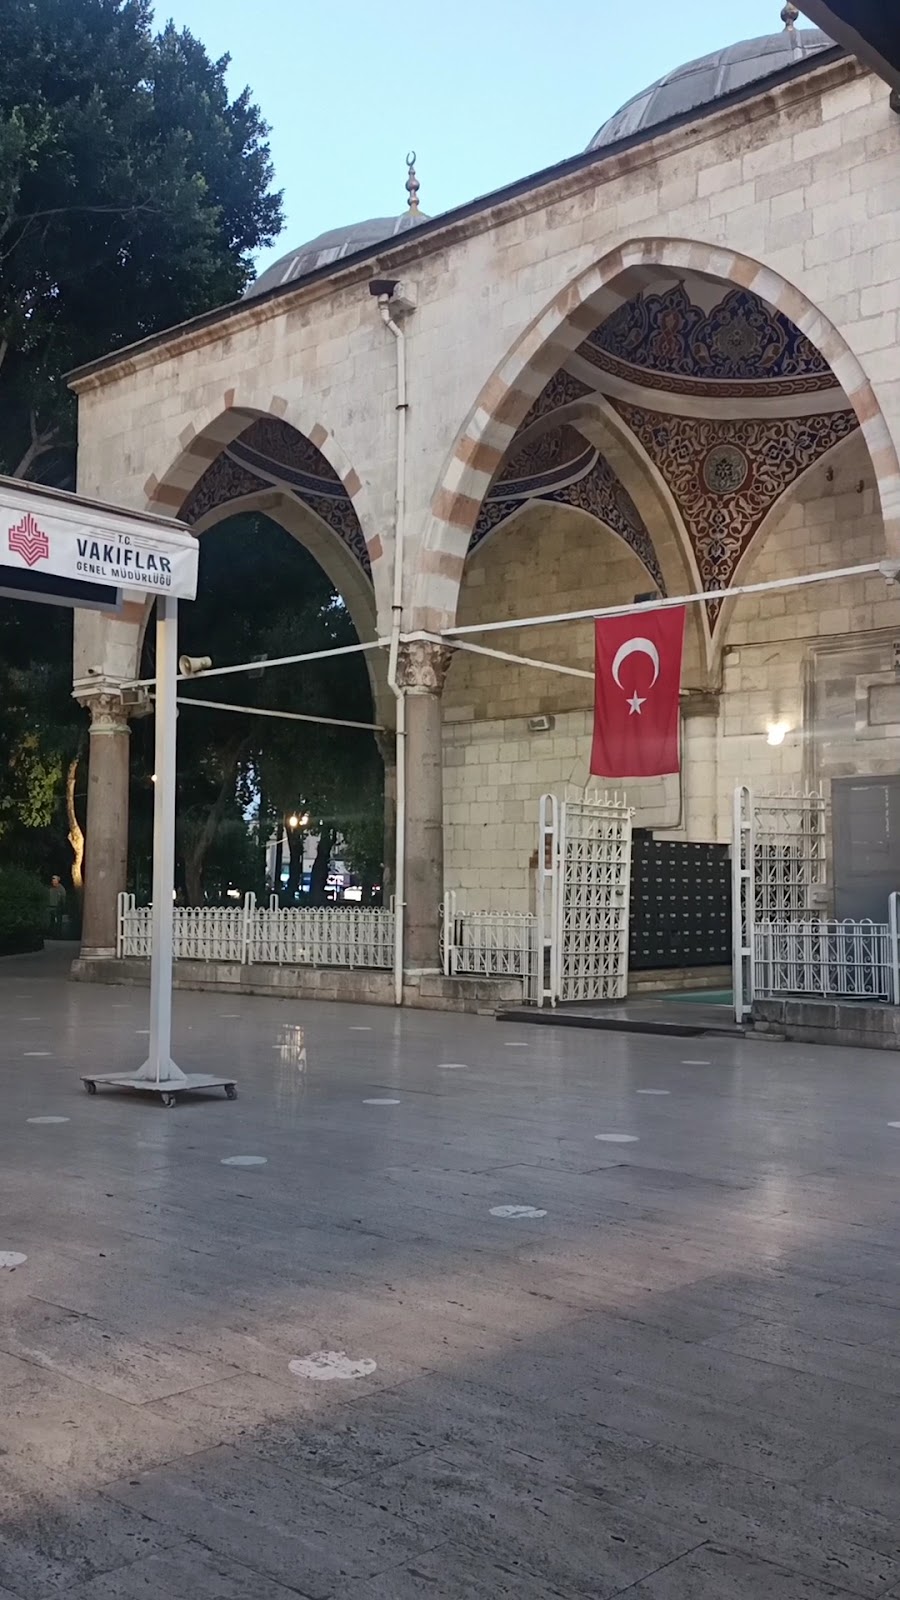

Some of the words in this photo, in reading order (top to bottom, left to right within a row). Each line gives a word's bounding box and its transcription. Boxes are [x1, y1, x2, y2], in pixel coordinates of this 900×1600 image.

[118, 535, 132, 545] T.C.
[77, 539, 171, 573] VAKIFLAR
[77, 562, 106, 575] GENEL
[111, 568, 171, 586] MÜDÜRLÜĞÜ
